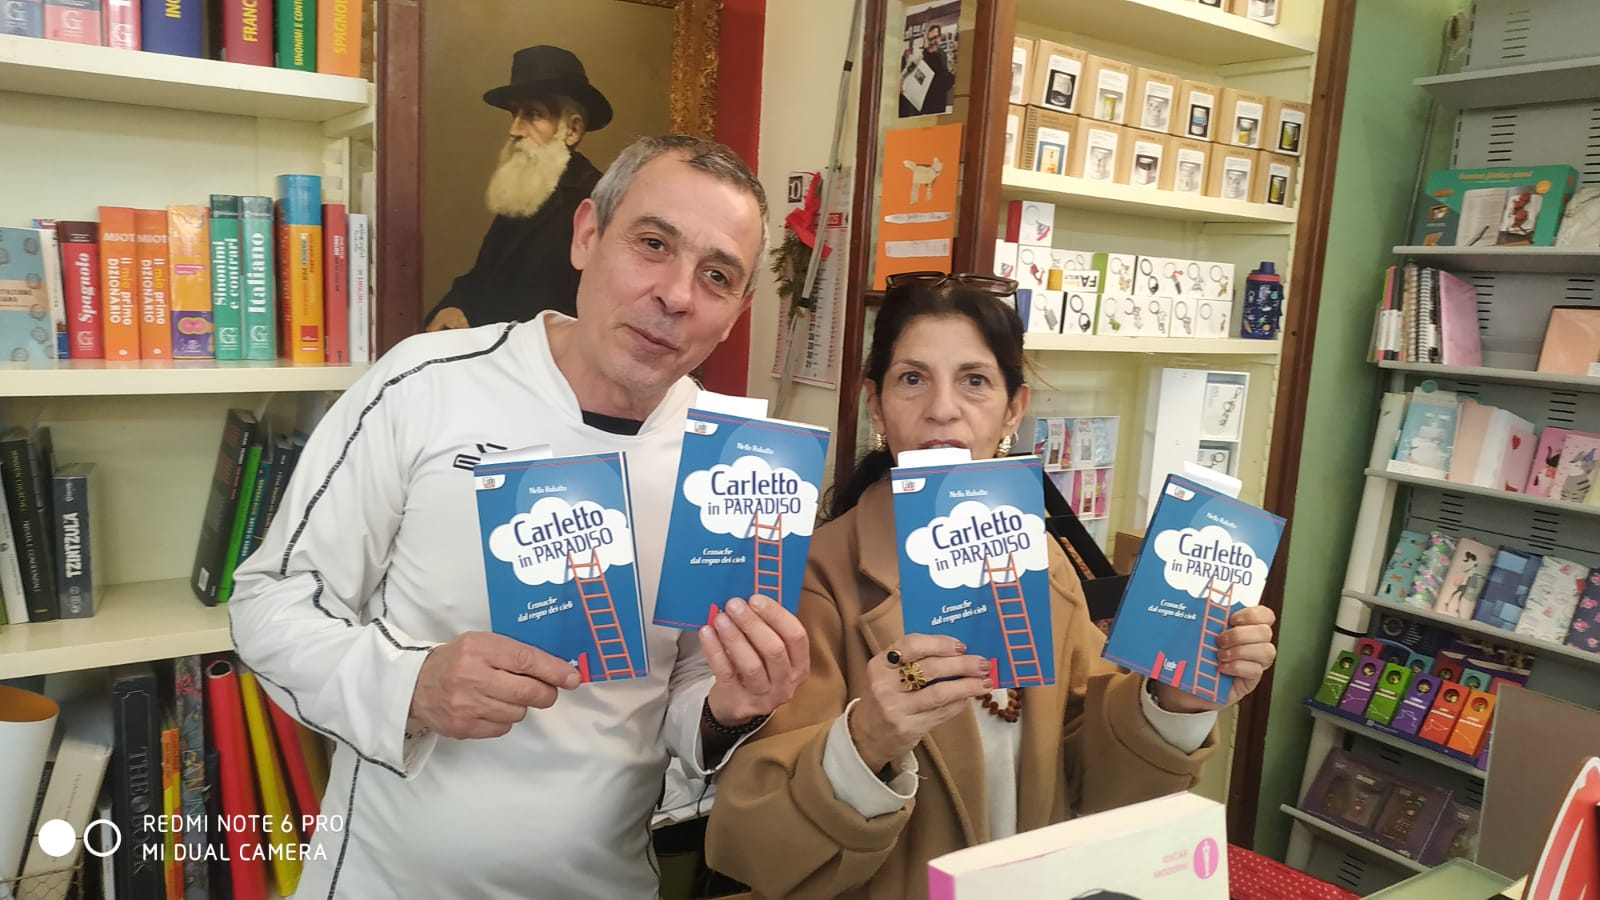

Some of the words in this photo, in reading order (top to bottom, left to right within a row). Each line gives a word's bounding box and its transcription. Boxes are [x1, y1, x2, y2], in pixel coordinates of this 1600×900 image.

[294, 29, 304, 66] SINONIMI
[212, 241, 227, 305] Sinonimi
[224, 238, 239, 297] contrari
[246, 233, 266, 313] Italiano
[75, 253, 97, 323] Spagnolo
[108, 258, 121, 324] DIZIONARIO
[141, 259, 155, 324] DIZIONARIO
[121, 292, 133, 325] primo
[154, 292, 166, 324] primo
[711, 471, 798, 496] Carletto
[707, 501, 720, 516] in
[725, 497, 801, 516] PARADISO
[514, 505, 604, 547] Carletto
[932, 510, 1022, 550] Carletto
[517, 554, 532, 568] in
[532, 527, 614, 564] PARADISO
[690, 556, 702, 565] dal
[701, 558, 720, 567] regno
[720, 556, 731, 564] dei
[731, 555, 746, 564] cieli
[702, 547, 733, 556] Cronache
[935, 558, 950, 571] in
[950, 532, 1030, 567] PARADISO
[1178, 533, 1252, 569] Carletto
[1171, 559, 1183, 573] in
[1186, 559, 1253, 586] PARADISO
[517, 613, 529, 622] dal
[529, 610, 547, 620] regno
[548, 604, 559, 614] dei
[559, 600, 573, 611] cieli
[527, 596, 558, 610] Cronache
[931, 616, 943, 626] dal
[942, 613, 962, 623] regno
[962, 609, 973, 618] dei
[973, 604, 988, 615] cieli
[942, 600, 973, 613] Cronache
